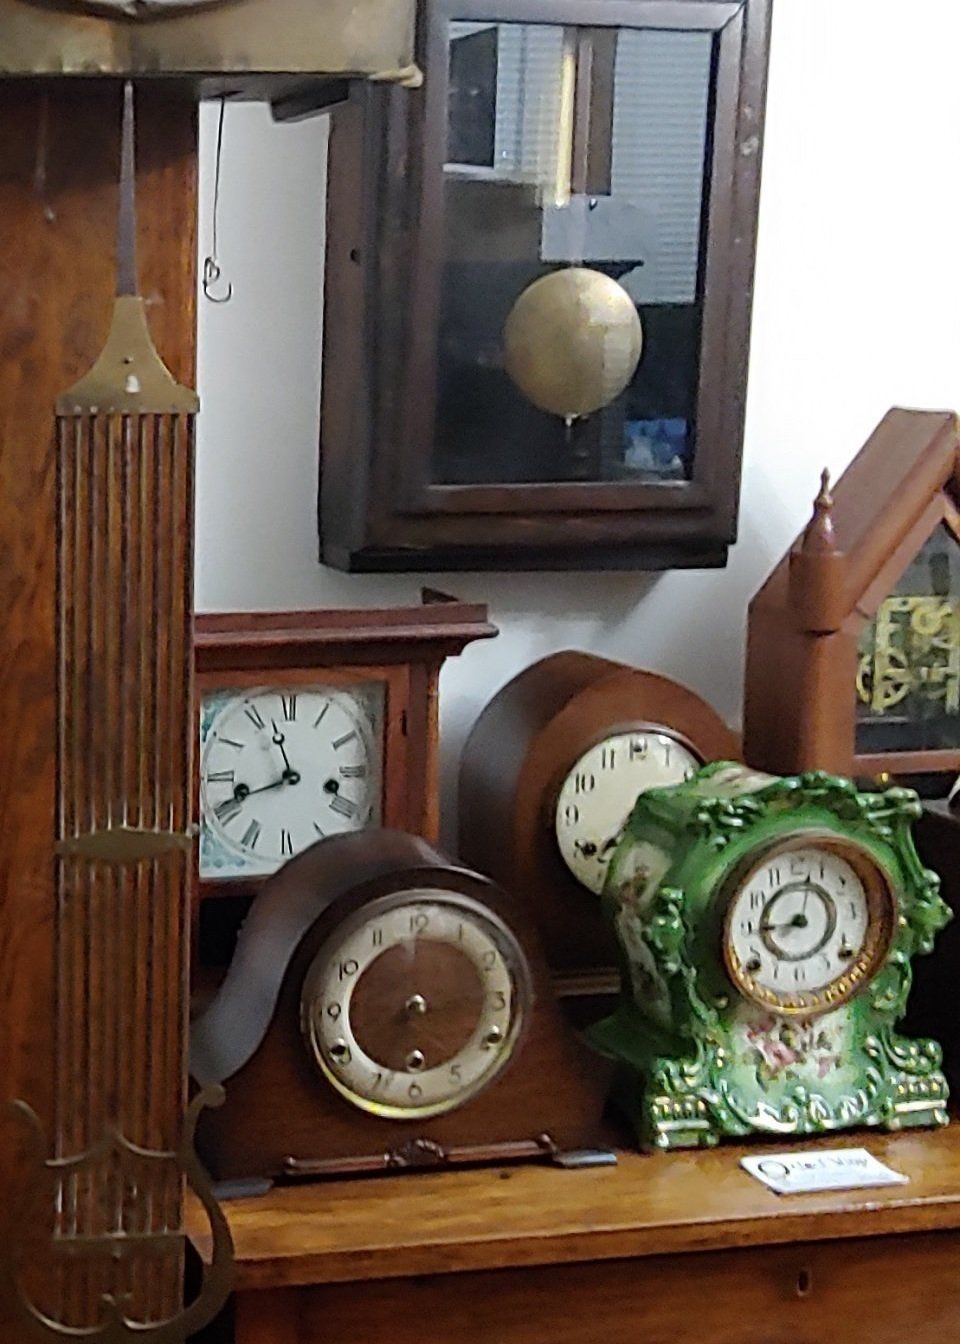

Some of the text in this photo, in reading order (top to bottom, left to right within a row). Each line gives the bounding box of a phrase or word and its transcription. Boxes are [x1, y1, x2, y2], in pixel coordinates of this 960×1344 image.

[602, 747, 616, 770] 11
[574, 771, 595, 795] 10
[769, 867, 781, 888] 11
[749, 890, 766, 910] 10
[409, 913, 430, 935] 12
[457, 923, 464, 941] 1
[372, 928, 383, 946] 11
[339, 959, 360, 981] 10
[493, 990, 507, 1010] 3
[326, 1003, 342, 1024] 9
[448, 1064, 463, 1085] 5
[408, 1082, 424, 1100] 6
